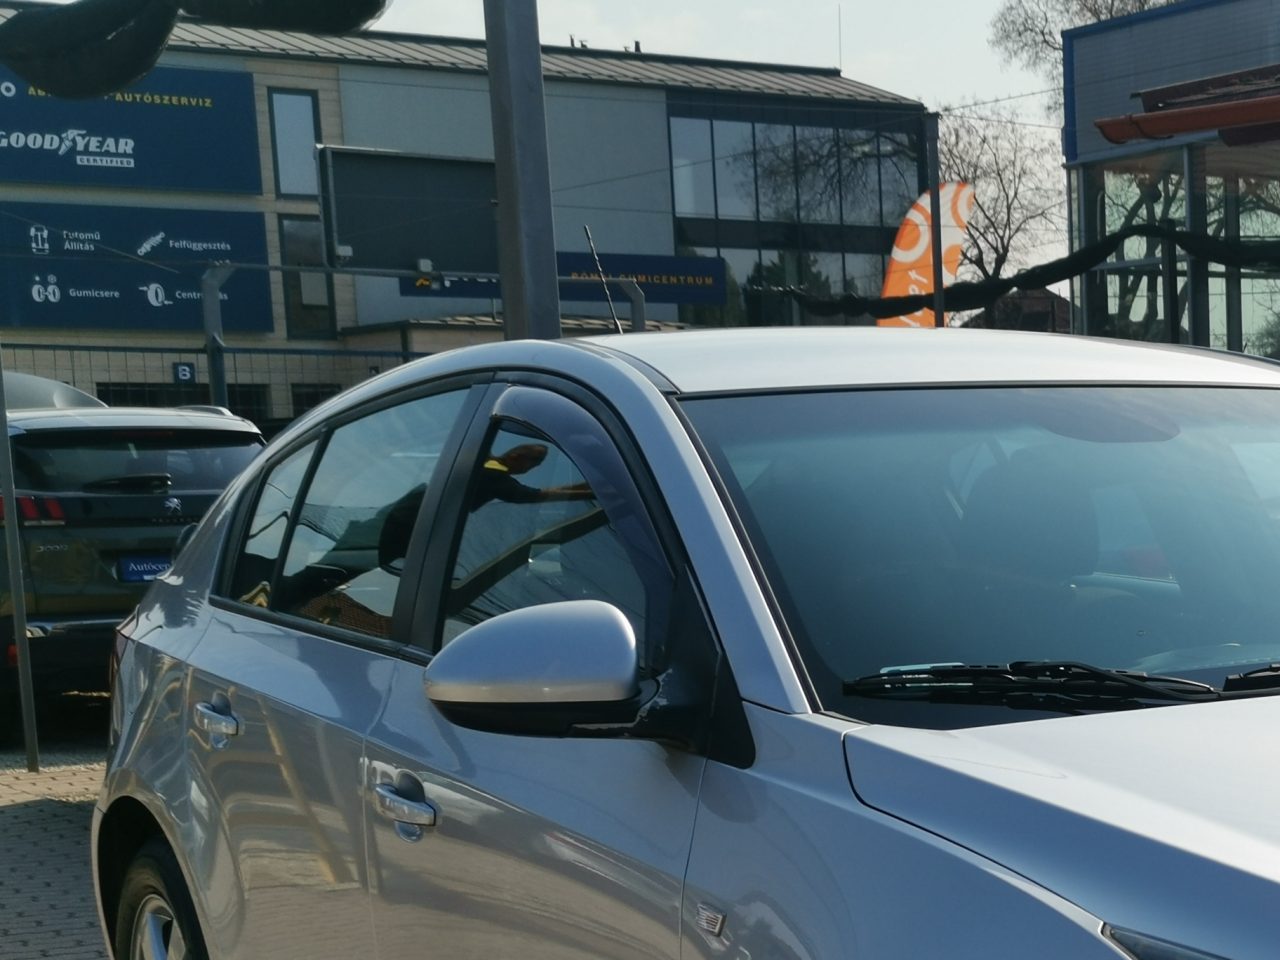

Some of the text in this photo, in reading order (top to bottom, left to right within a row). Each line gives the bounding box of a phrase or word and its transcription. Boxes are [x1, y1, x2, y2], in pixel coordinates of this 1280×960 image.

[79, 156, 133, 167] CERTIFIED
[169, 240, 231, 252] Felfüggesztés
[69, 288, 120, 299] Gumicsere
[178, 366, 191, 380] B
